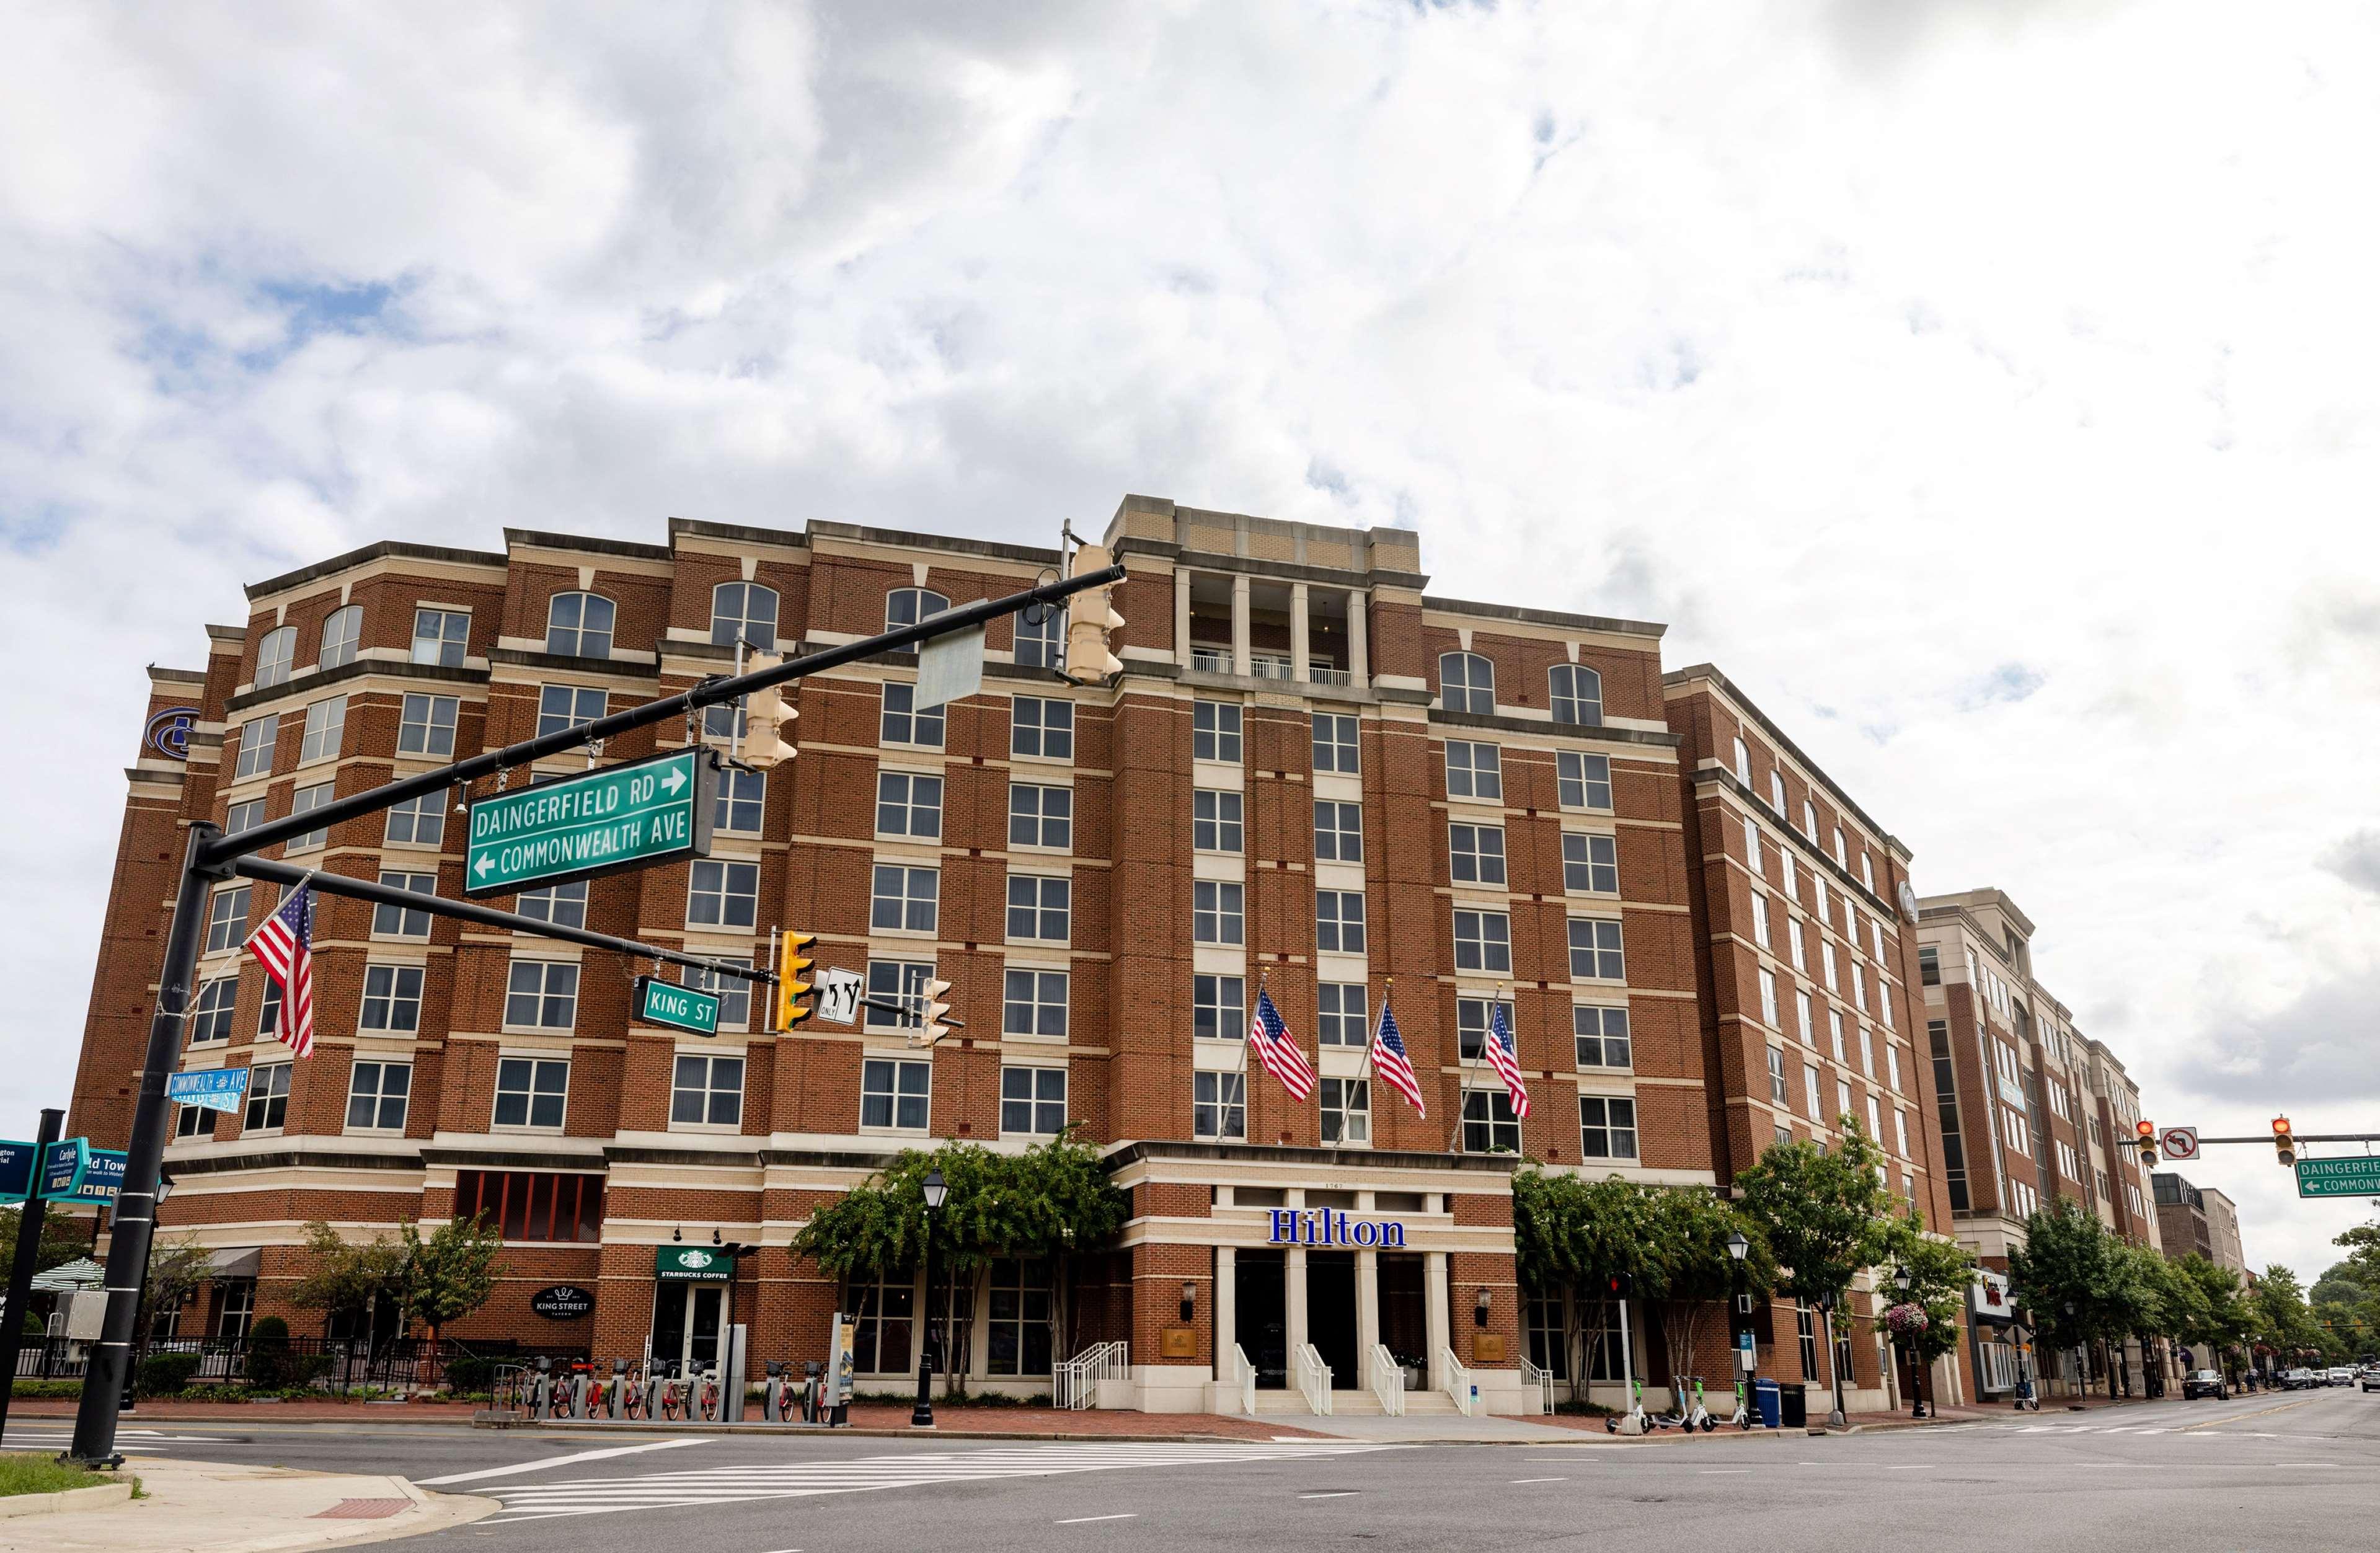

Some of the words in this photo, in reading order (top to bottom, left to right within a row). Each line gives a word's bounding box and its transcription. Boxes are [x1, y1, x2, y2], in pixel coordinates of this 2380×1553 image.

[476, 785, 619, 838] DAINGERFIELD
[630, 774, 655, 805] RD
[501, 821, 641, 874] COMMONWEALTH
[651, 811, 685, 844] AVE
[651, 992, 688, 1017] KING
[695, 1003, 712, 1022] ST
[821, 1006, 835, 1016] ONLY
[171, 1073, 214, 1093] COMMONWEALTH
[229, 1071, 246, 1089] AVE
[223, 1092, 237, 1108] ST
[59, 1148, 76, 1162] Carlyle
[89, 1157, 100, 1169] ld
[104, 1159, 126, 1171] Tow
[2301, 1162, 2380, 1175] DAINGERFIE
[1267, 1206, 1407, 1247] Hilton
